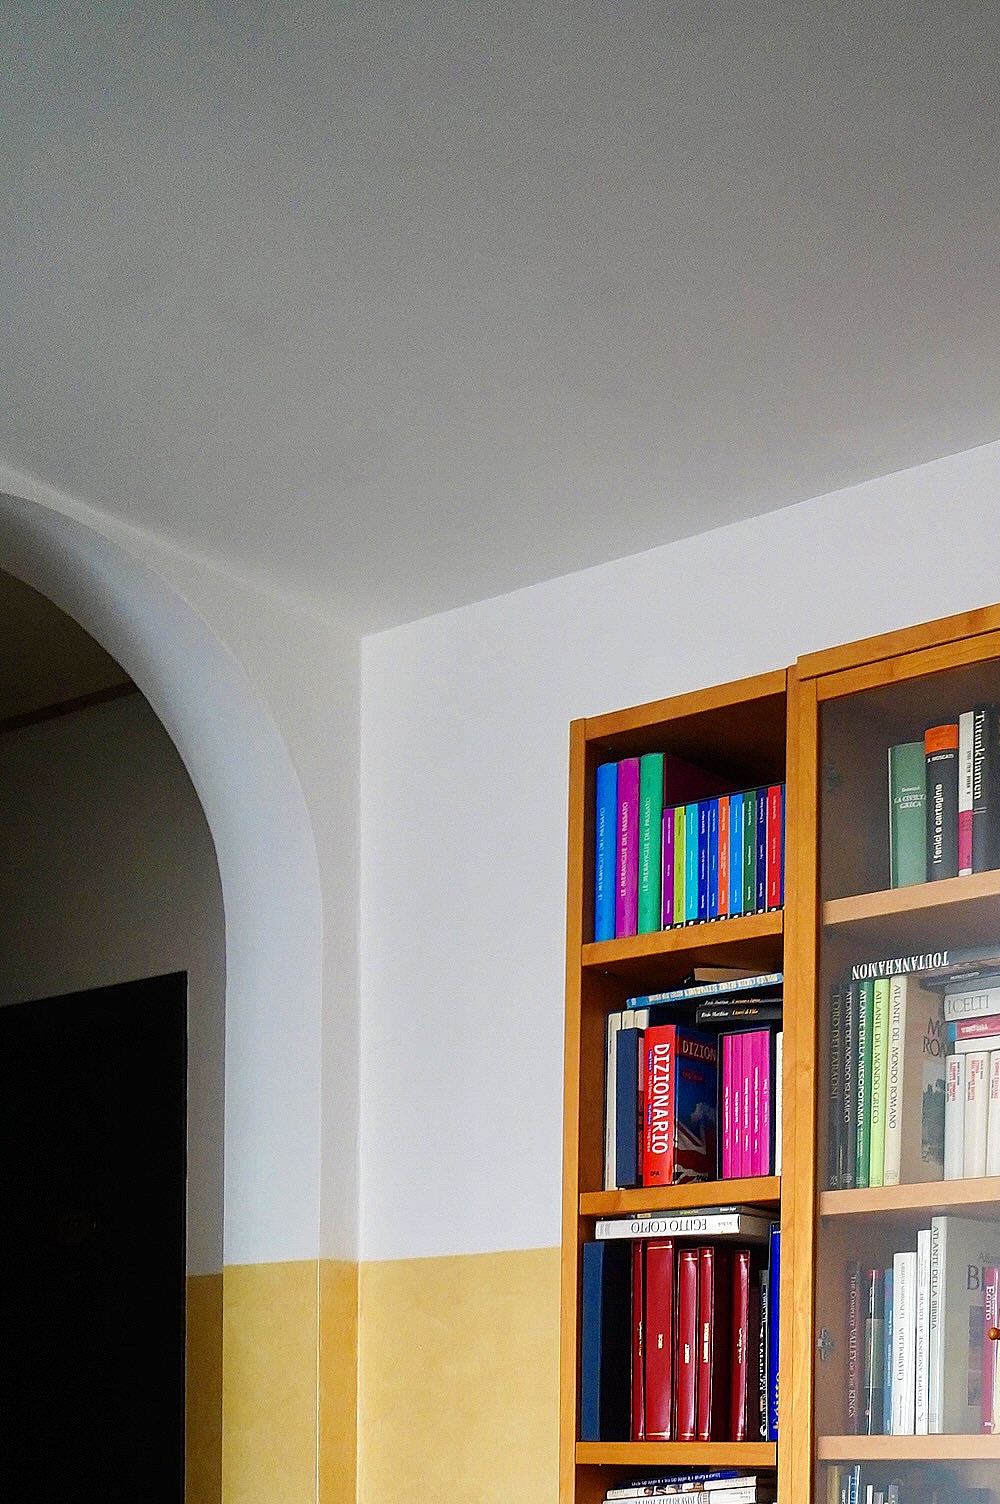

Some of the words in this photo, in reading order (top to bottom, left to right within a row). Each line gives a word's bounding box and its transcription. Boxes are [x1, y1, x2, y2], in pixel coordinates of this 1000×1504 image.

[974, 710, 986, 801] Tutankhamen
[850, 950, 949, 980] TOUTANKHAMON
[859, 989, 867, 1028] ATLANTE
[892, 984, 901, 1026] ATLANTE
[952, 994, 990, 1013] CELTI
[874, 1032, 882, 1049] DEL
[891, 1027, 899, 1044] DEL
[873, 1053, 881, 1093] MONDO
[890, 1046, 899, 1084] MONDO
[651, 1043, 671, 1155] DIZIONARIO
[857, 1060, 866, 1128] MESOPOTAMIA
[872, 1094, 880, 1125] GRECO
[889, 1087, 898, 1130] ROMANO
[630, 1220, 667, 1233] COPTO
[669, 1219, 707, 1233] EGITTO
